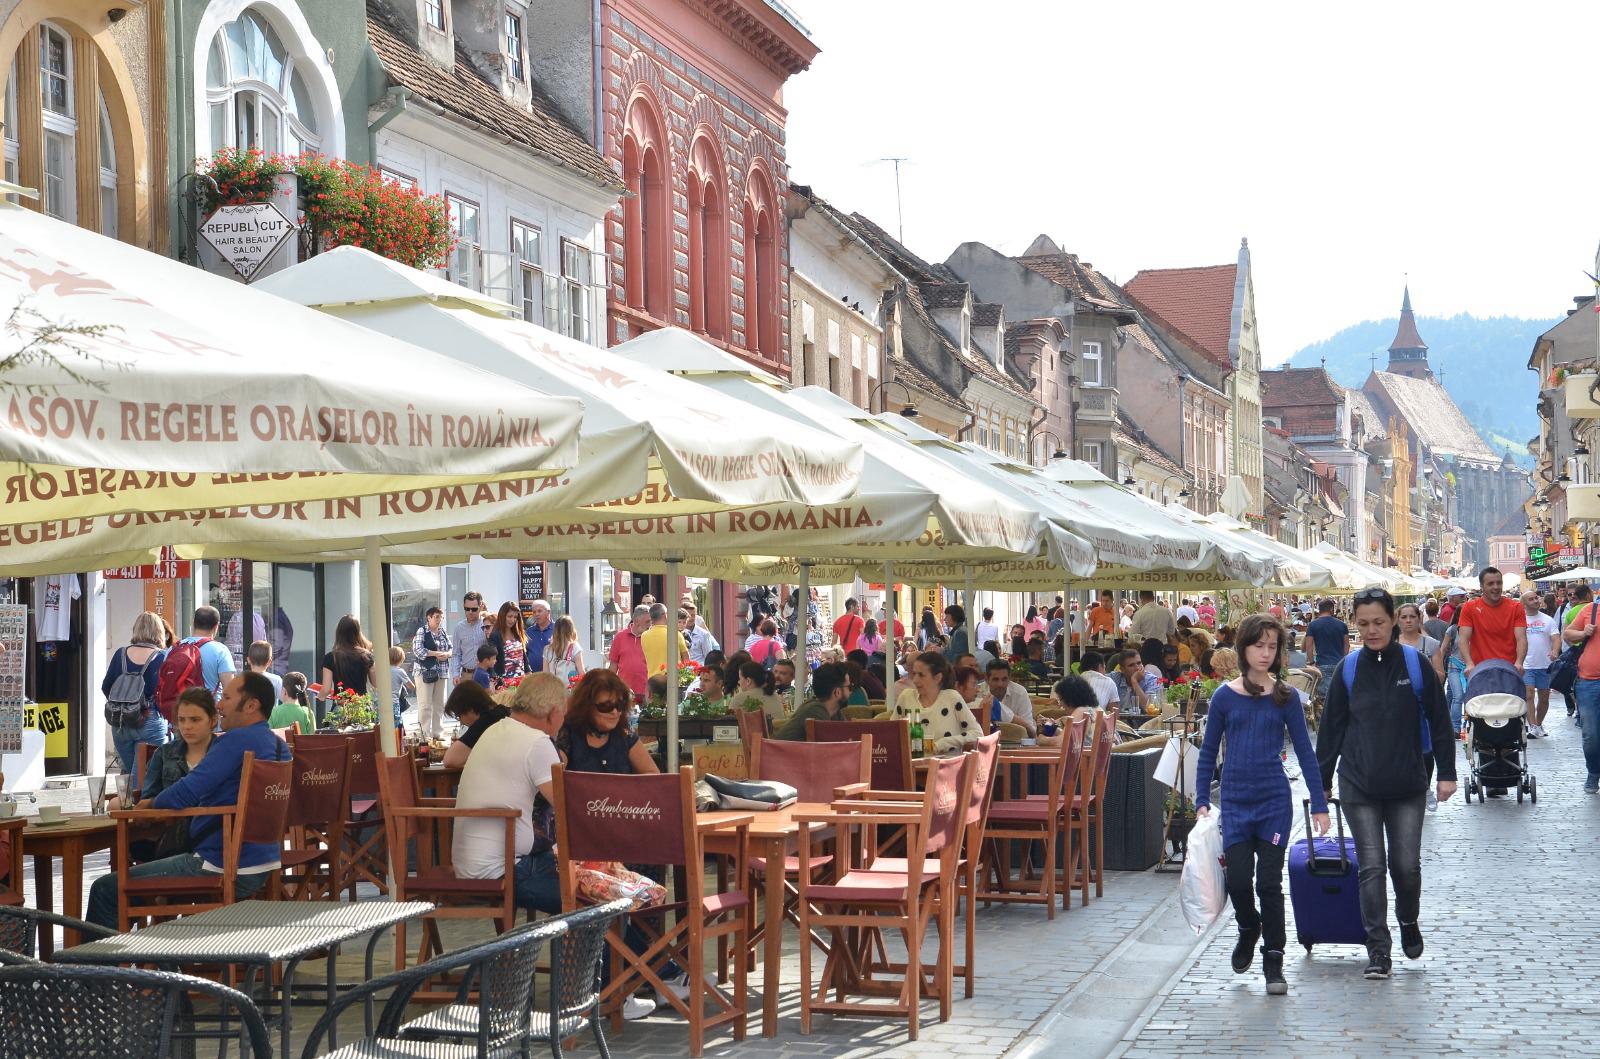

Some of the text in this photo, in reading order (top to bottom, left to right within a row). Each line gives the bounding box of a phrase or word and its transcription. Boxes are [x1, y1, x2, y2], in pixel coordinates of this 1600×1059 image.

[215, 235, 279, 246] HAIR & BEAUTY
[233, 245, 262, 254] SALON
[120, 401, 239, 443] REGELE
[408, 403, 433, 448] ÎN
[441, 408, 556, 449] ROMÂNIA.
[586, 796, 661, 815] Ambasador
[586, 810, 661, 821] RESTAURANT
